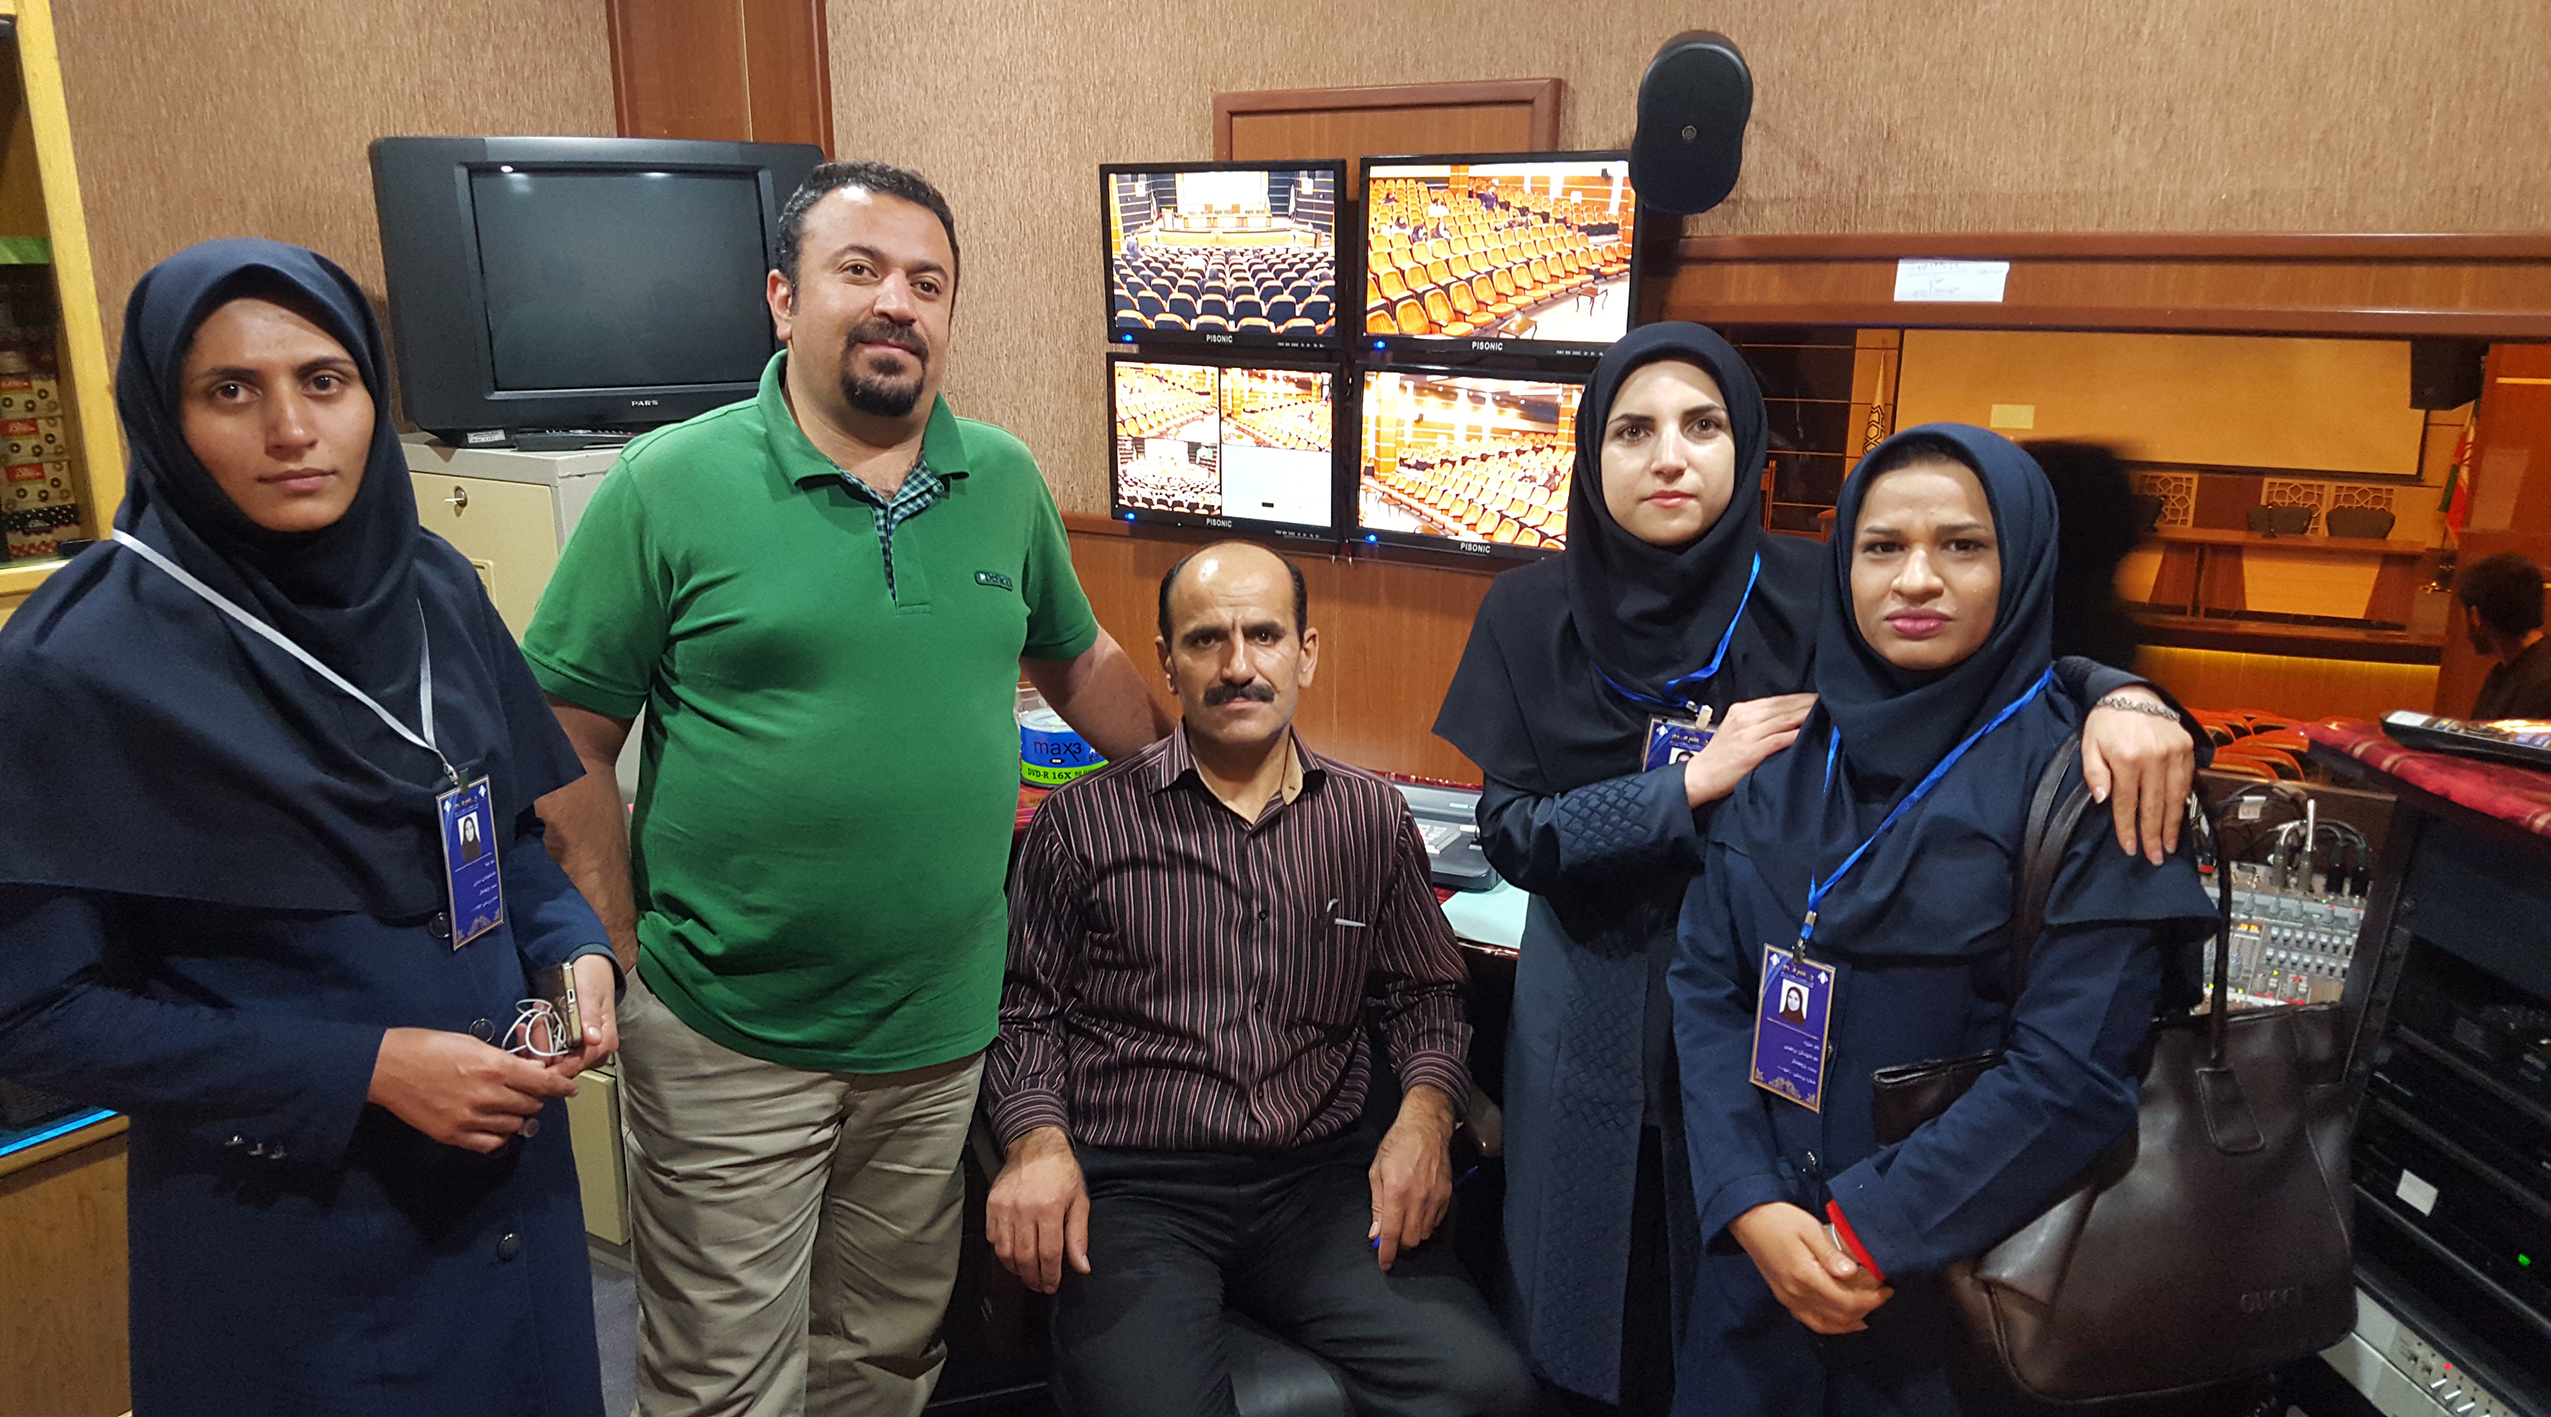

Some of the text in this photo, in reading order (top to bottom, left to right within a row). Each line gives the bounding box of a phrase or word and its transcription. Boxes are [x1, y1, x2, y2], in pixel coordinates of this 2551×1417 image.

[1206, 334, 1233, 344] PISONIC
[1472, 341, 1504, 351] PISONIC
[1206, 517, 1232, 528] PISONIC
[1460, 542, 1491, 554] PISONIC
[1034, 741, 1082, 763] max3
[1027, 767, 1050, 779] DVD-R
[1052, 771, 1072, 780] 16X
